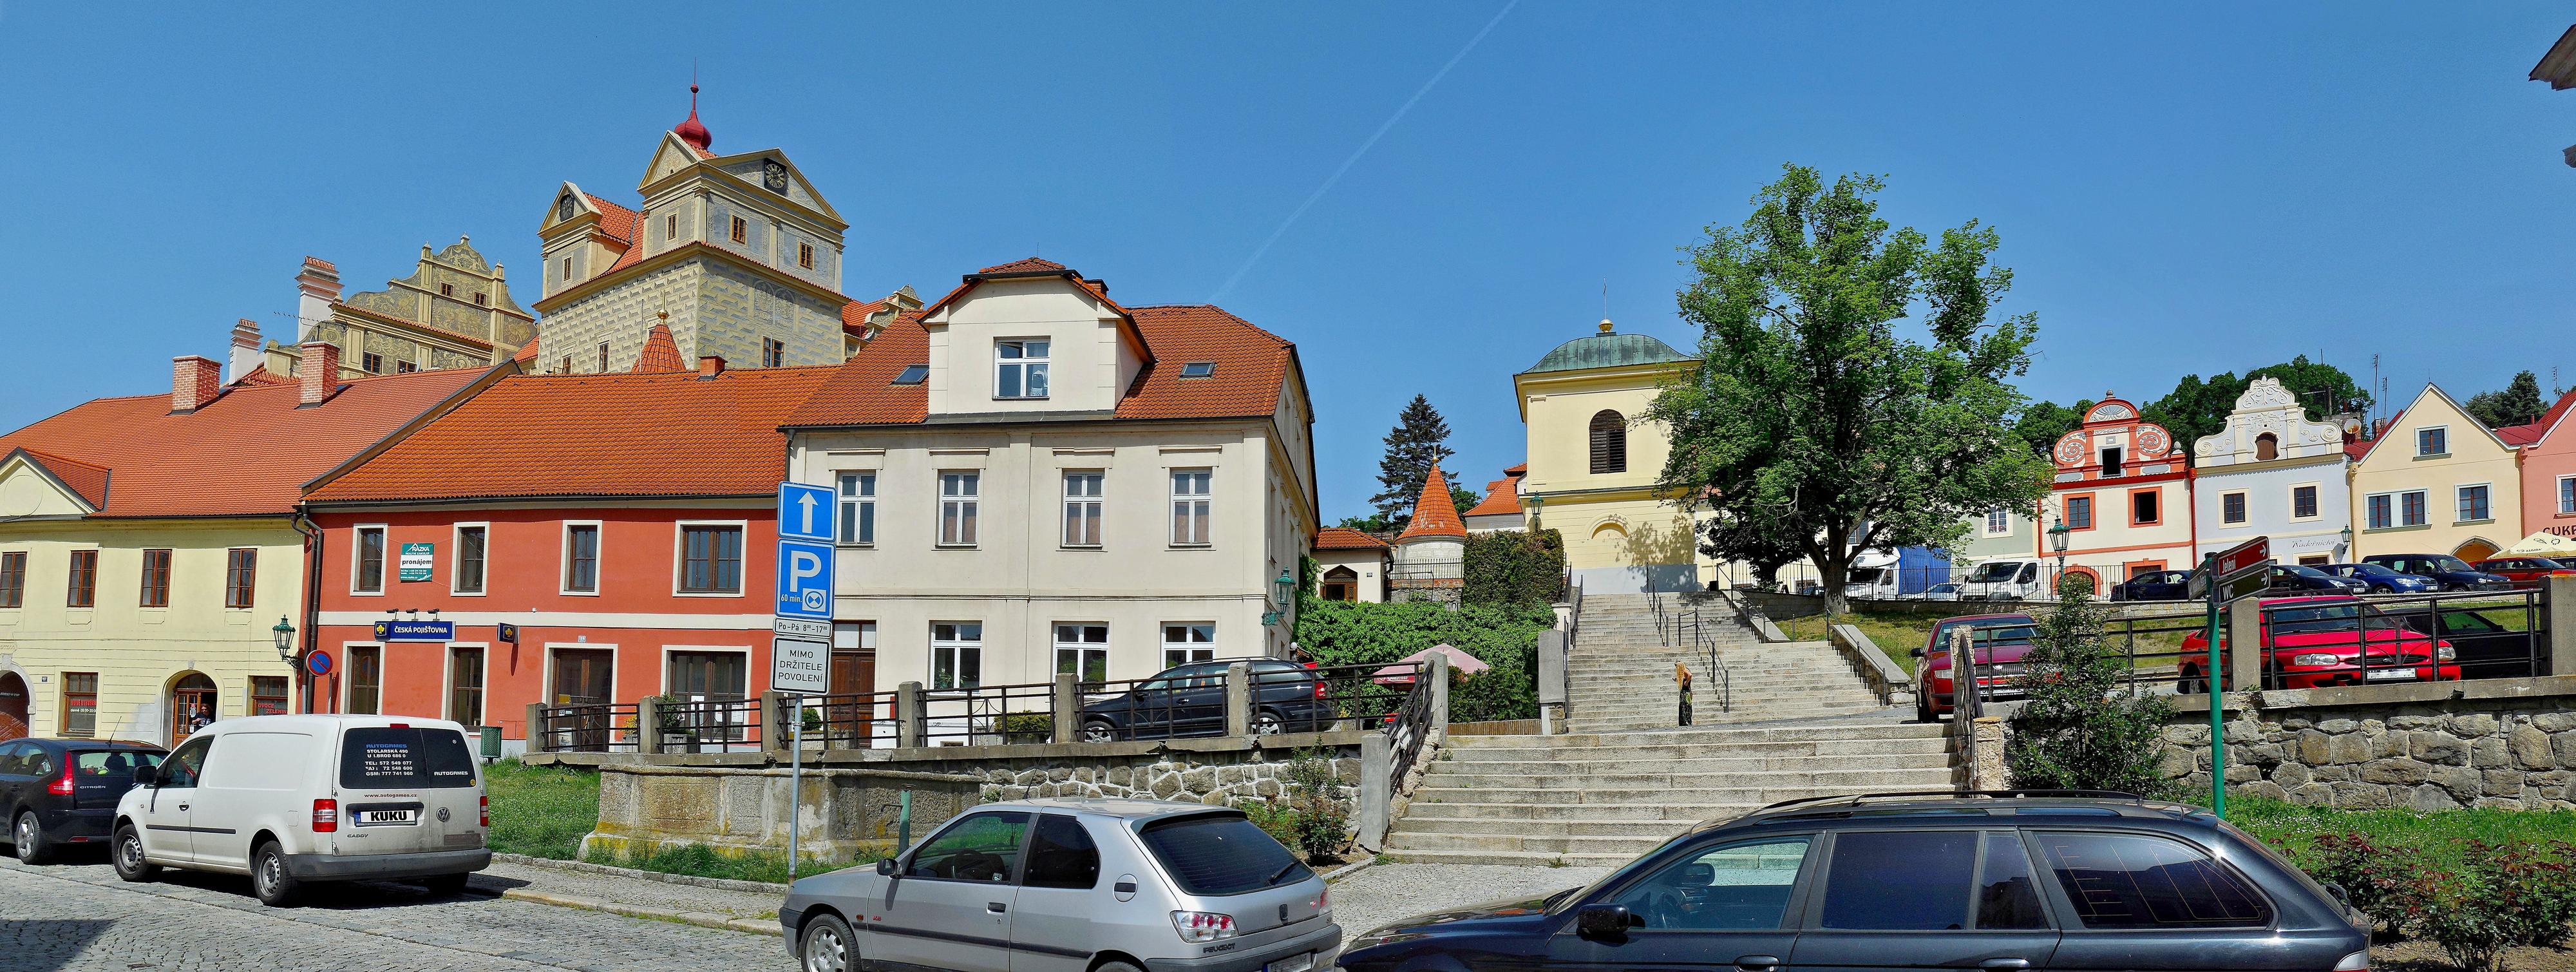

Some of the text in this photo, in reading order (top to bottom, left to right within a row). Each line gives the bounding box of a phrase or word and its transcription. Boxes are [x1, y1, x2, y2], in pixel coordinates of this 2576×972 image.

[2222, 555, 2236, 574] Jelení
[790, 550, 822, 593] P
[2222, 584, 2233, 600] WC
[413, 625, 447, 634] POJIŠŤOVNA
[790, 649, 813, 658] MIMO
[780, 660, 822, 671] DRŽITELE
[778, 672, 823, 683] POVOLENÍ
[370, 811, 407, 821] KUKU
[1203, 942, 1236, 954] PEUGEOT
